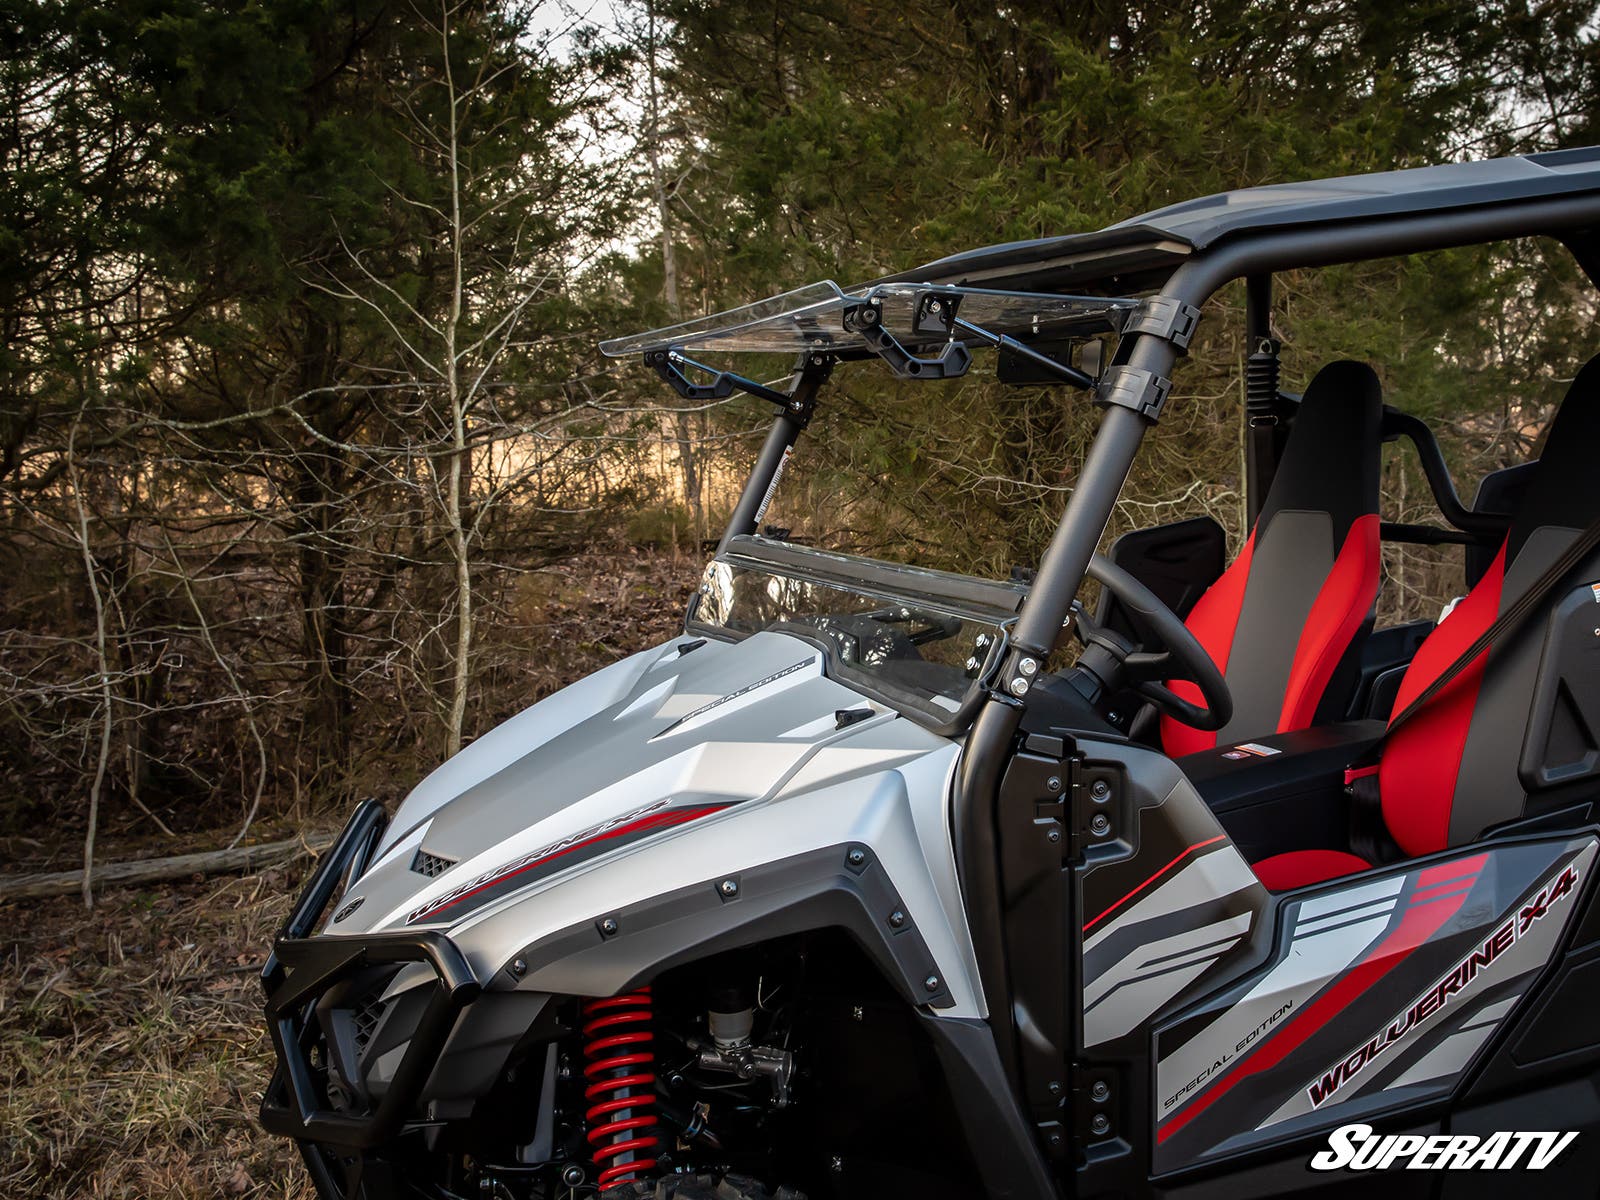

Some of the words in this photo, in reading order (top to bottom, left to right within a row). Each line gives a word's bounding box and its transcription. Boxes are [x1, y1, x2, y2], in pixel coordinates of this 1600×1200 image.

[682, 690, 746, 722] SPECIAL
[748, 662, 805, 690] EDITION
[1306, 915, 1516, 1110] WOLVERINE
[1518, 863, 1579, 939] X4
[1164, 1054, 1233, 1110] SPECIAL
[1235, 999, 1293, 1053] EDITION
